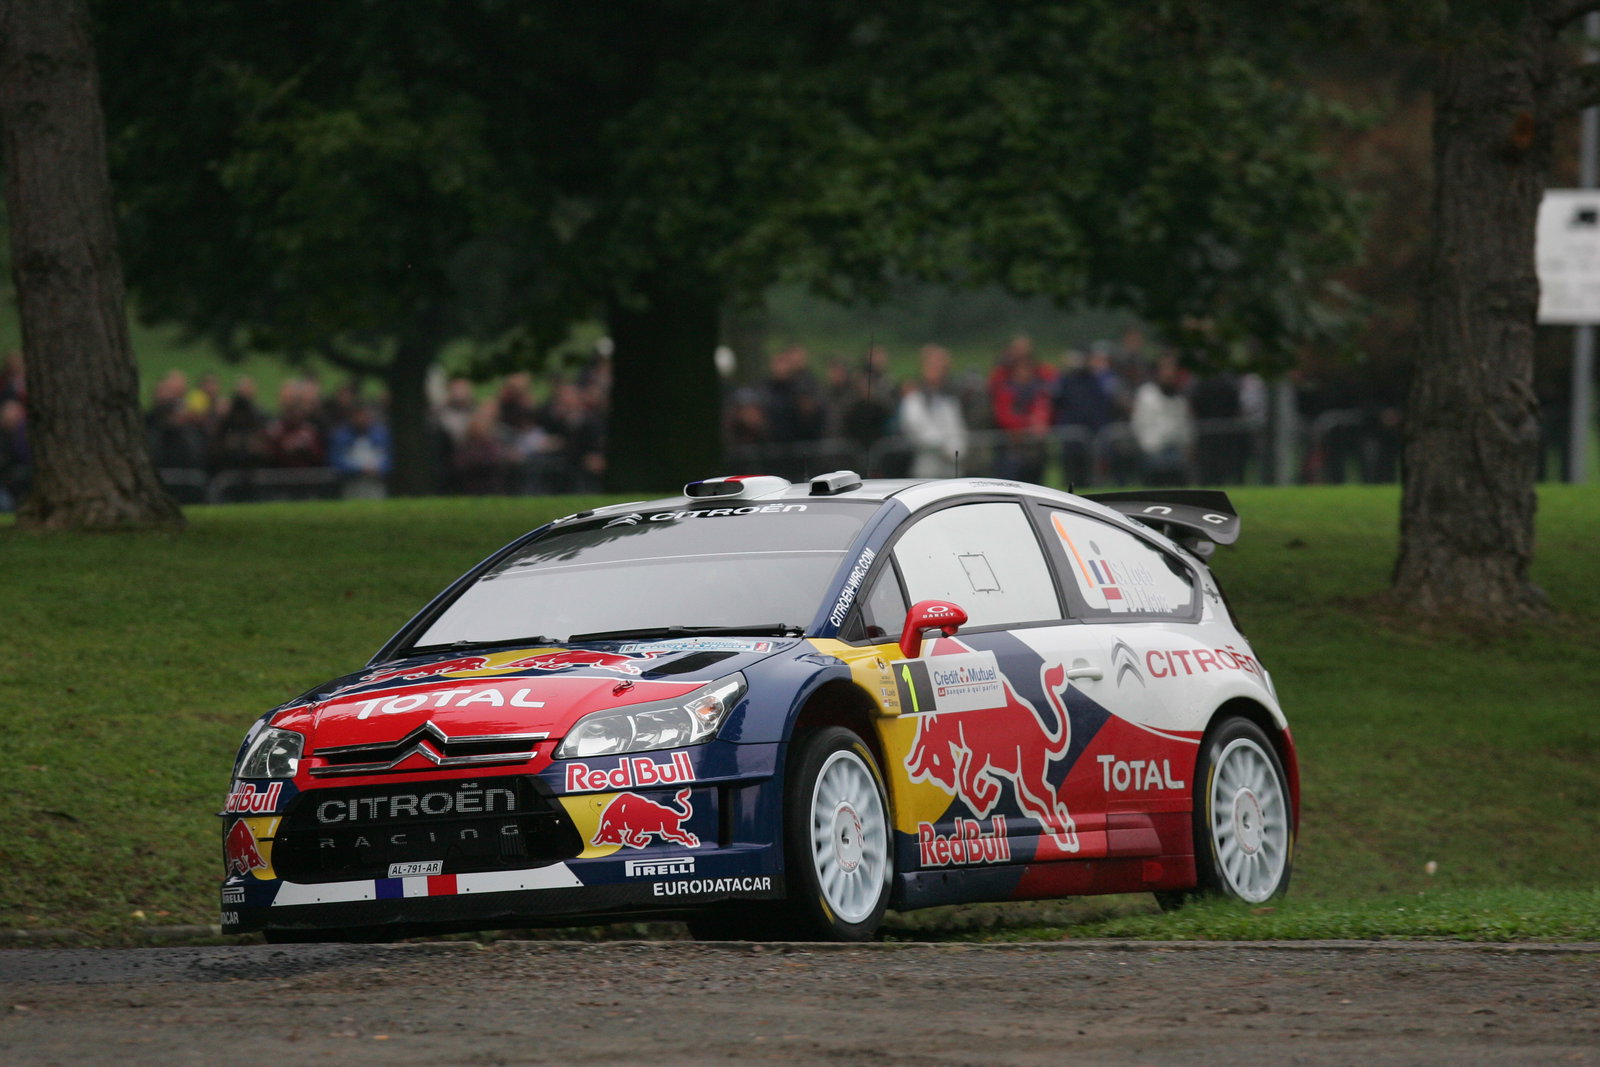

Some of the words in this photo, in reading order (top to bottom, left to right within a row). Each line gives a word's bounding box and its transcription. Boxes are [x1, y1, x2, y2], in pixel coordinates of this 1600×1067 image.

[830, 547, 876, 627] CITROEN-WRC.COM
[901, 664, 919, 713] 1
[933, 667, 960, 686] Crédit
[969, 666, 997, 682] Mutuel
[355, 688, 546, 720] TOTAL
[566, 758, 631, 792] Red
[632, 751, 696, 786] Bull
[1097, 754, 1185, 792] TOTAL
[237, 782, 283, 813] Bull
[918, 817, 966, 867] Red
[963, 814, 1011, 863] Bull
[391, 862, 439, 876] AL-791-AR
[625, 856, 695, 877] PIRELLI
[653, 876, 771, 896] EURODATACAR
